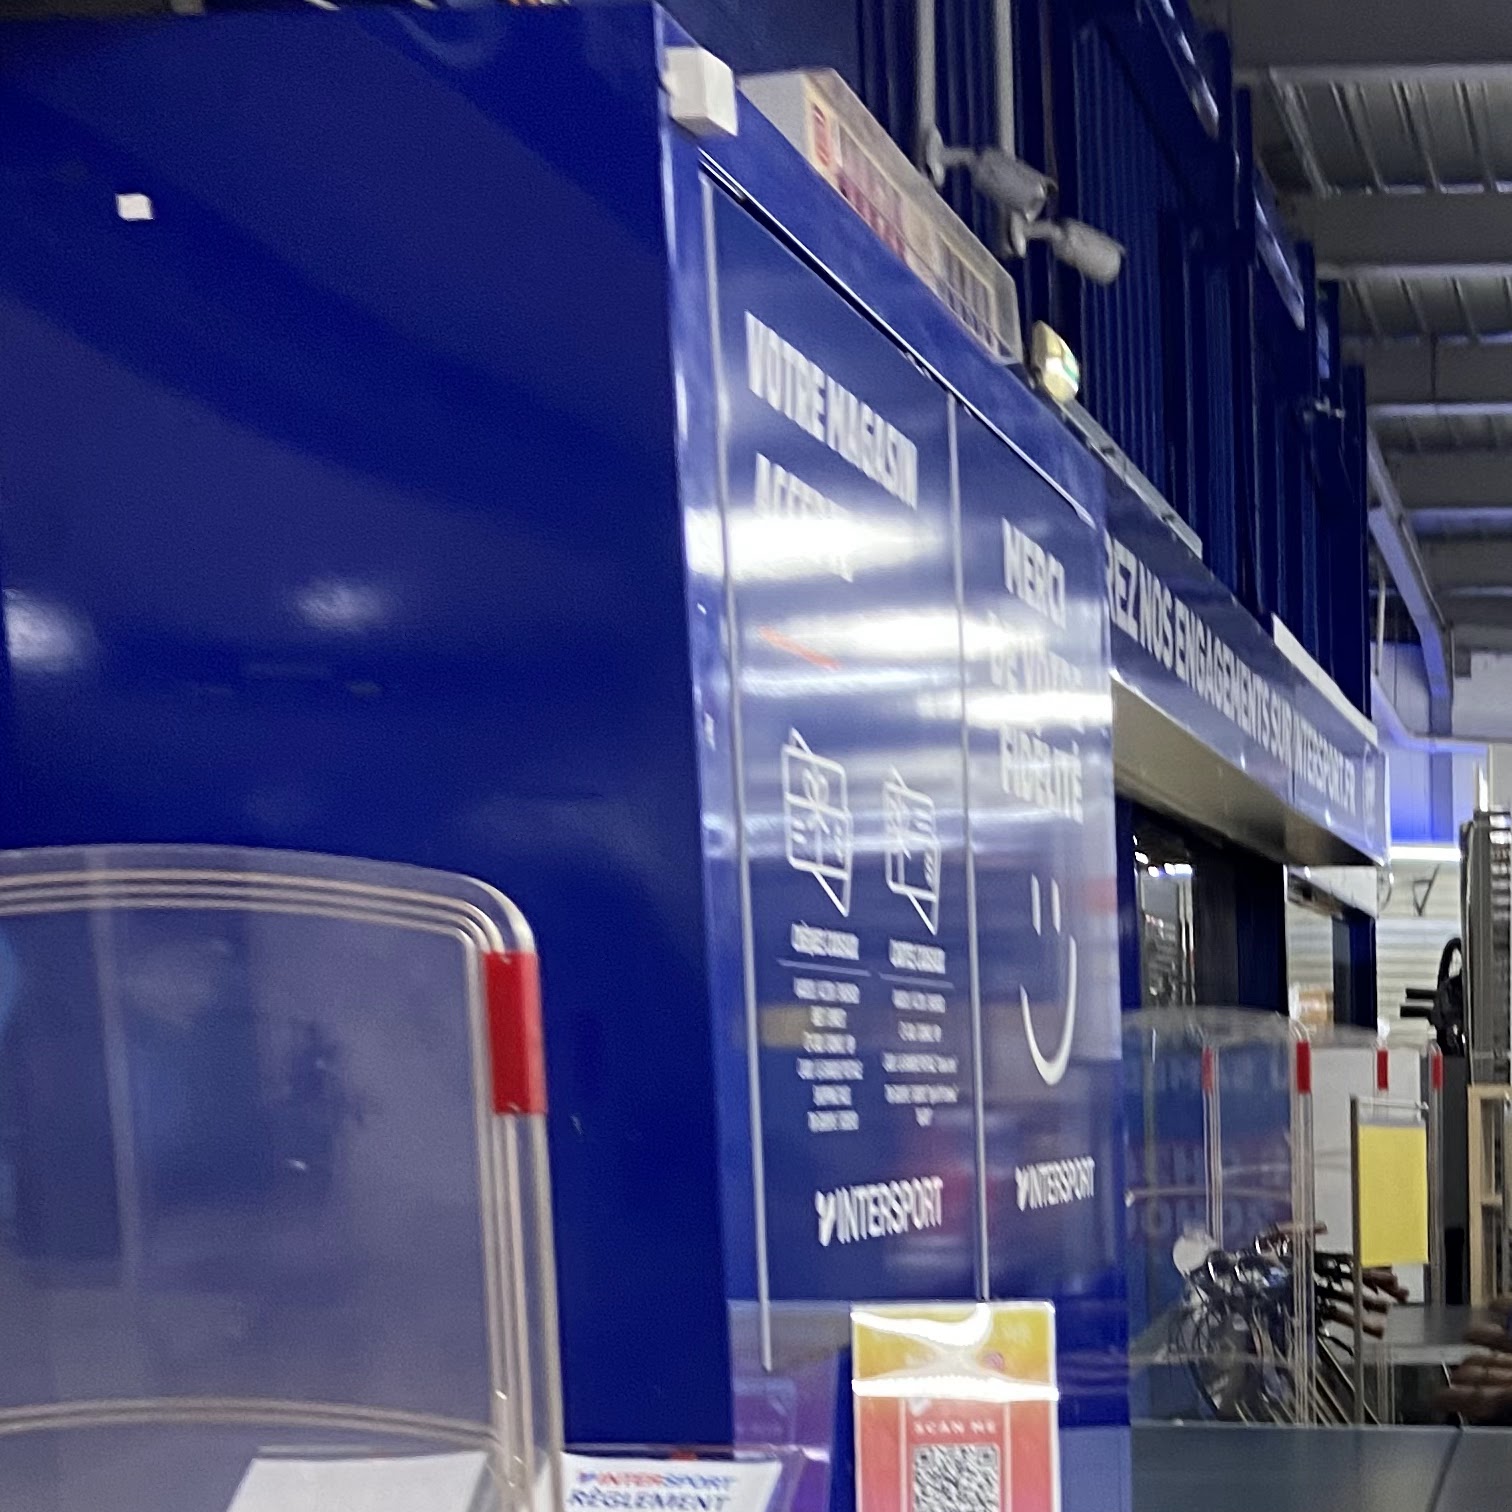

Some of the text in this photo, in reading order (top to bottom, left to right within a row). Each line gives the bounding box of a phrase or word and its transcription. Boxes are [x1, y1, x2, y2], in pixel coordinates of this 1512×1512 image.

[744, 309, 918, 511] VOTRE MAGASIN
[1002, 517, 1066, 630] MERCI
[1138, 559, 1174, 671] NOS
[815, 1176, 944, 1248] INTERSPORT
[1015, 1156, 1095, 1212] INTERSPORT
[913, 1420, 965, 1435] SCAN
